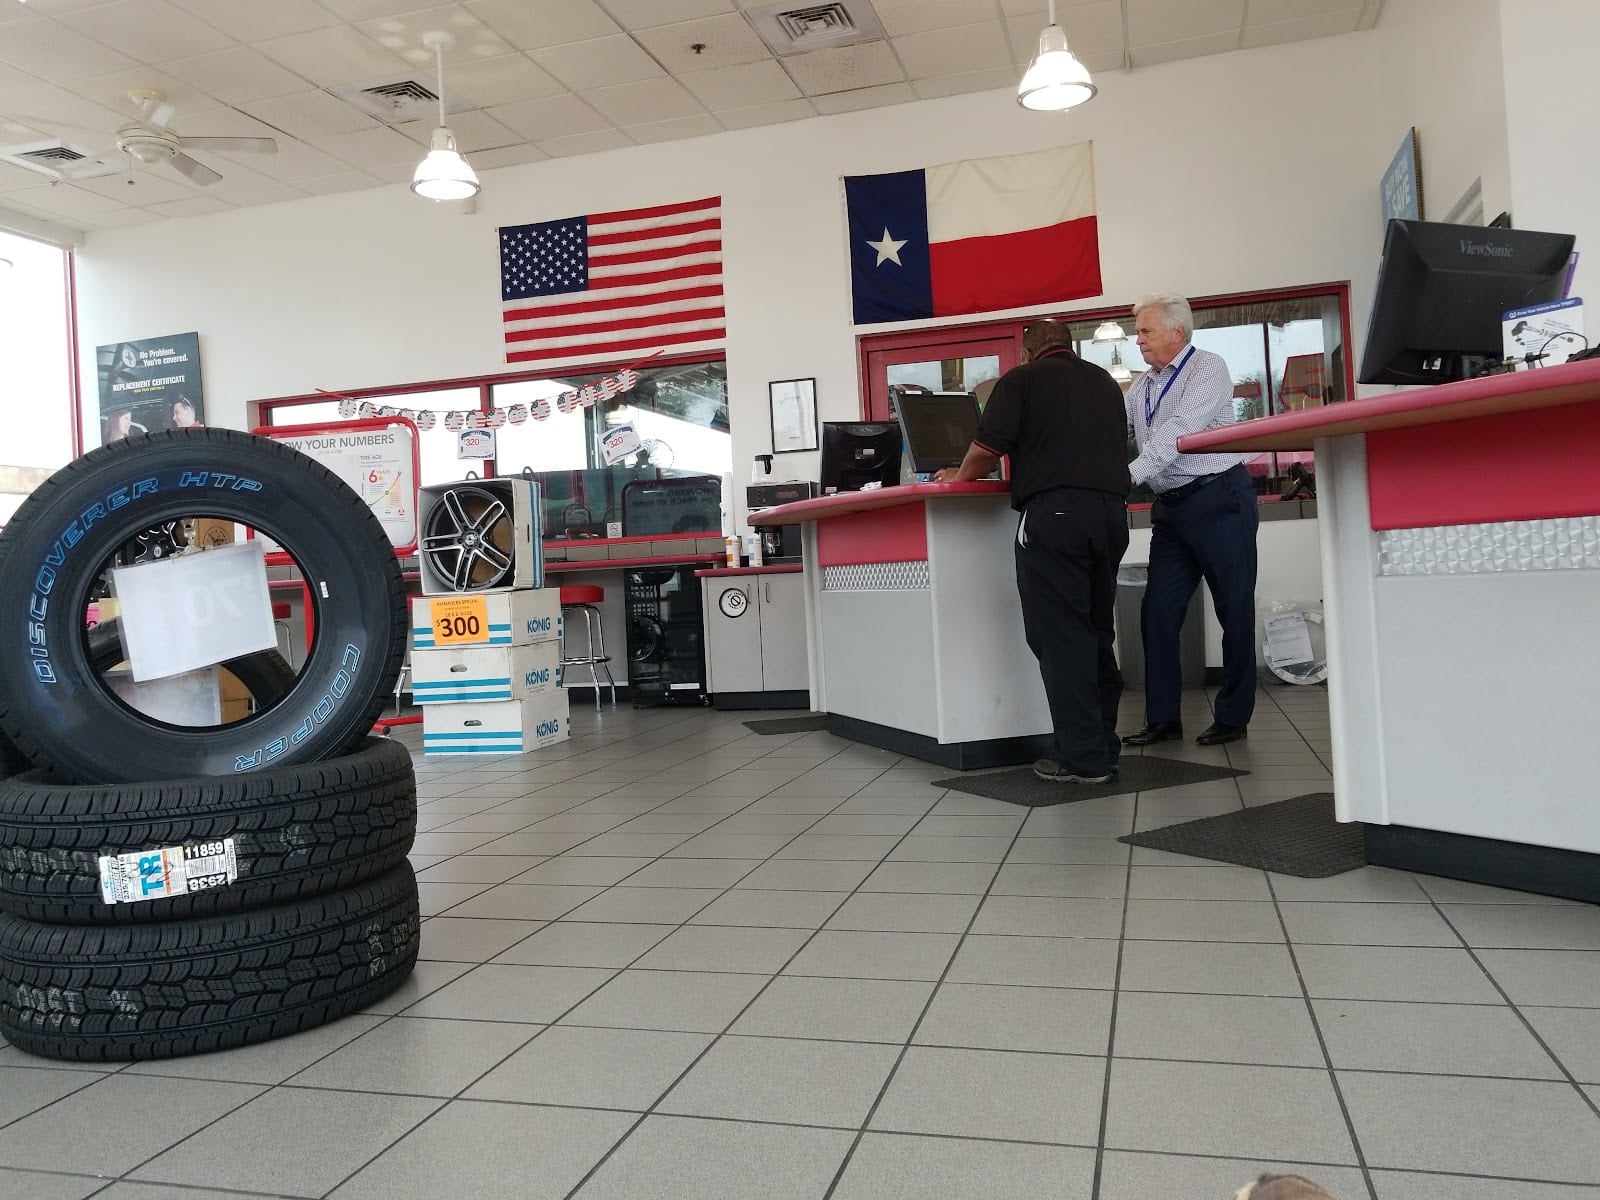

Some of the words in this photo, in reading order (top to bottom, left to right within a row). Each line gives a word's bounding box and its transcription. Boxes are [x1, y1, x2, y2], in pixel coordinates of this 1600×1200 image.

[1460, 240, 1514, 258] ViewSonic
[140, 350, 148, 360] No
[149, 348, 176, 358] Problem.
[143, 358, 162, 367] You're
[163, 354, 188, 364] covered.
[112, 379, 151, 392] REPLACEMENT
[152, 374, 186, 386] CERTIFICATE
[305, 438, 336, 450] YOUR
[340, 434, 395, 448] NUMBERS
[368, 470, 378, 483] 6
[28, 476, 160, 684] DISCOVERER
[178, 472, 263, 493] HTP
[436, 616, 480, 637] $300
[527, 616, 550, 634] KÖNIG
[526, 668, 549, 686] KÖNIG
[235, 643, 360, 772] COOPER
[536, 719, 558, 737] KÖNIG
[185, 842, 224, 859] 11859
[140, 854, 164, 896] TR
[189, 874, 226, 891] 2938
